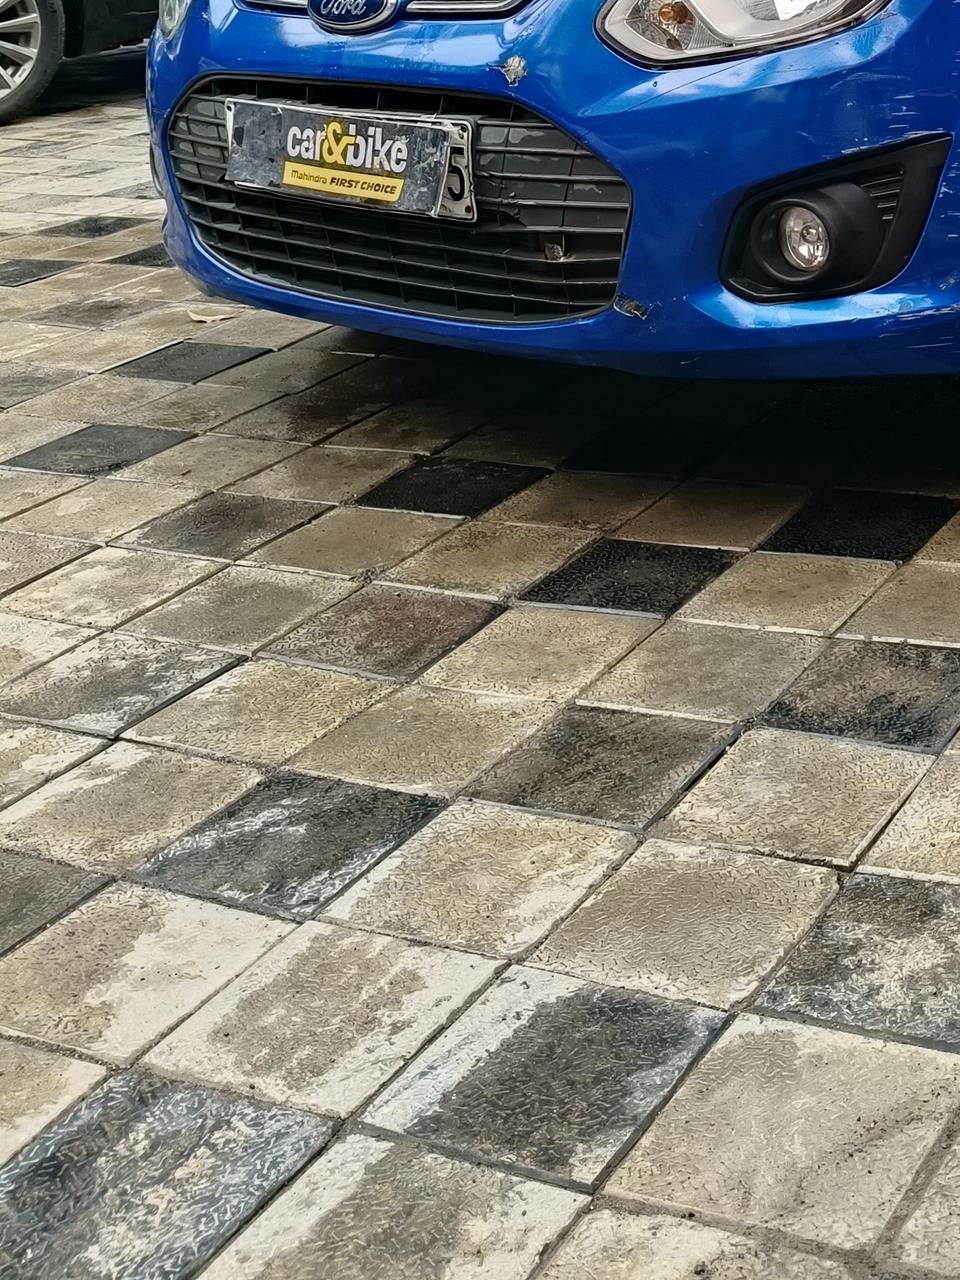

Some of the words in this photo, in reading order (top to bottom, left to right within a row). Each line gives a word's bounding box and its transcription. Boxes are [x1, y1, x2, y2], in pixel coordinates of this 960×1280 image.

[286, 121, 409, 173] car&bike
[291, 169, 328, 184] Mahindra
[329, 176, 361, 189] FIRST
[360, 181, 398, 195] CHOICE
